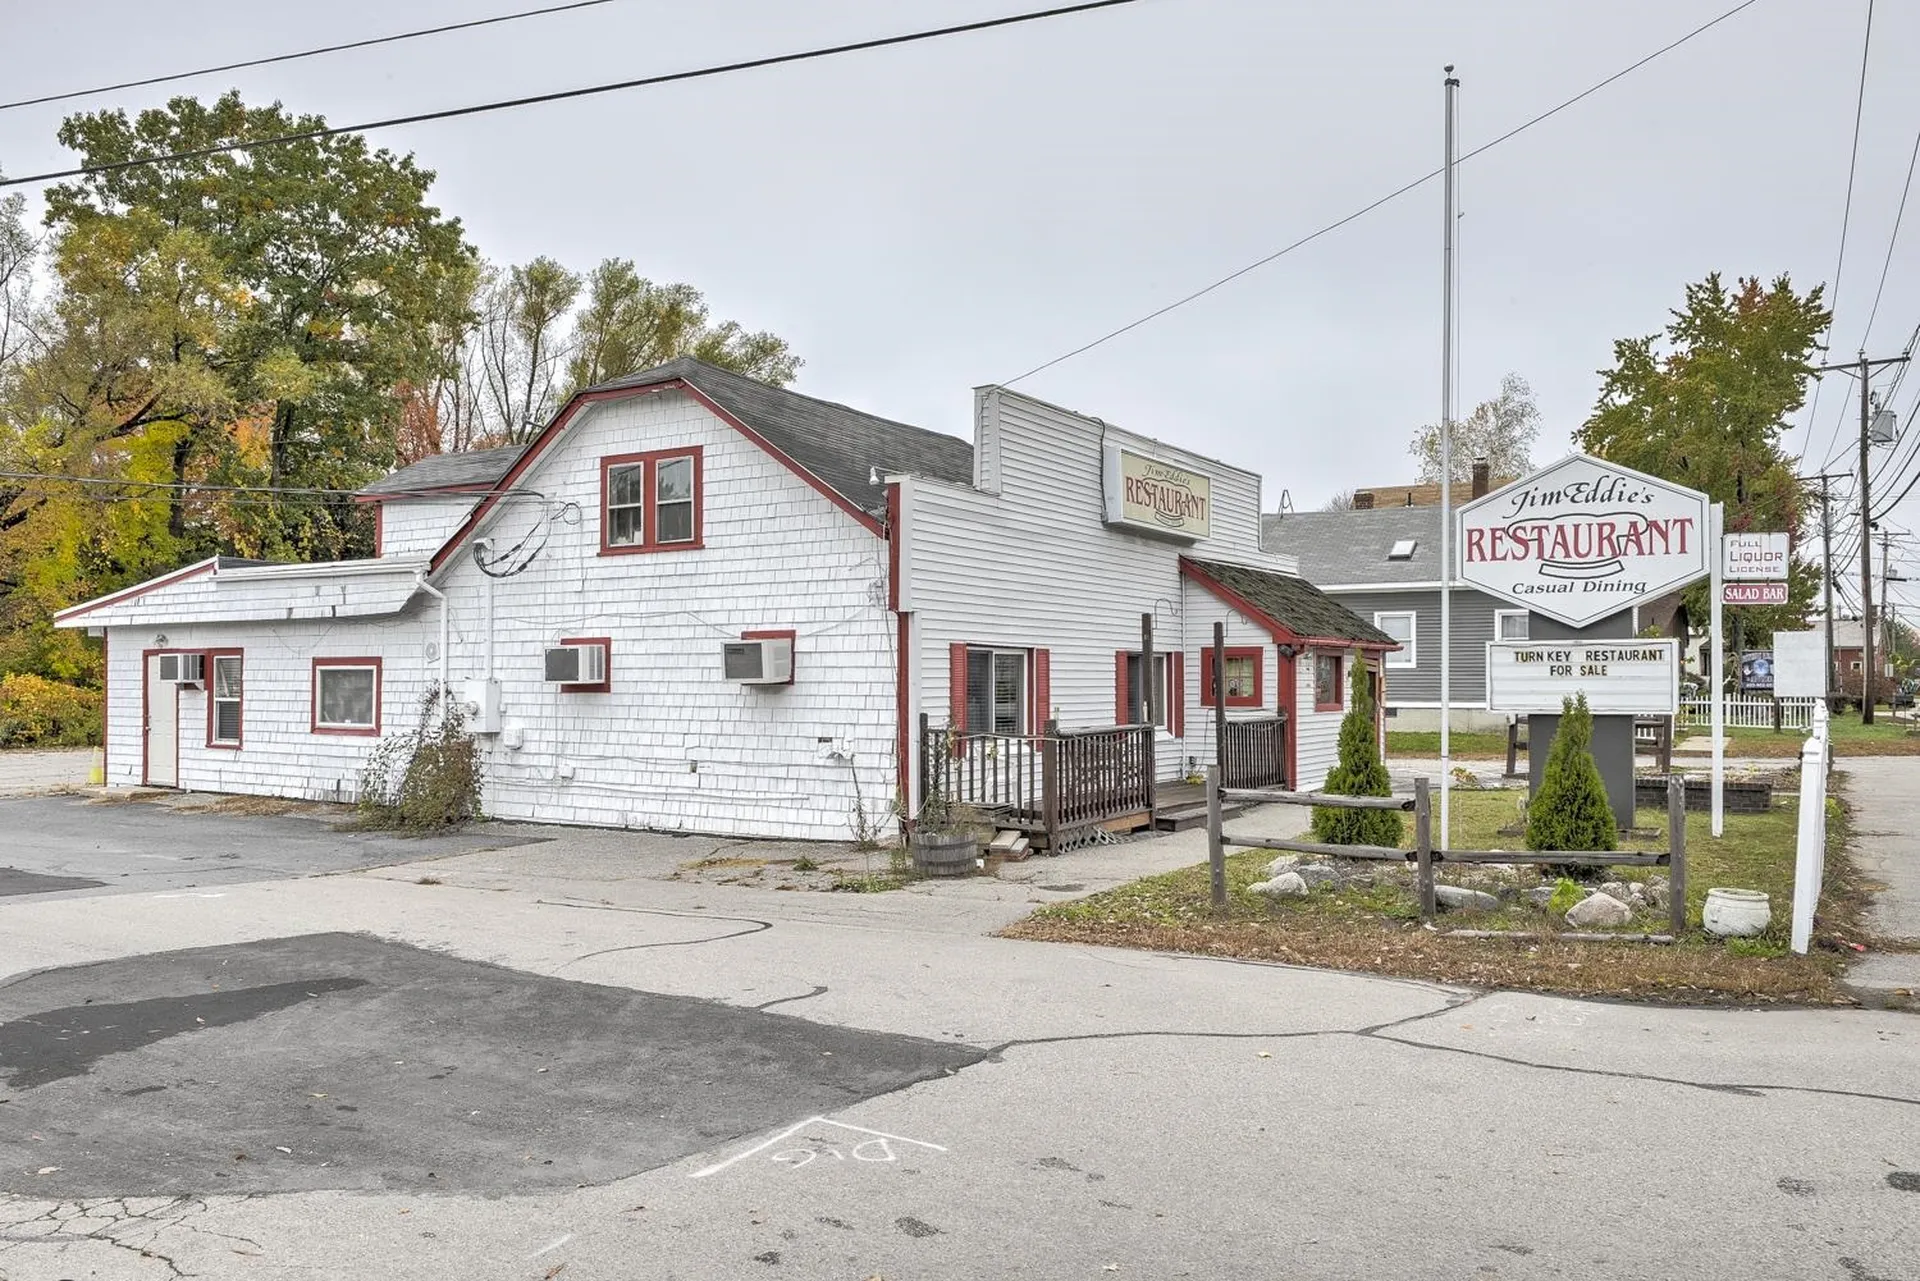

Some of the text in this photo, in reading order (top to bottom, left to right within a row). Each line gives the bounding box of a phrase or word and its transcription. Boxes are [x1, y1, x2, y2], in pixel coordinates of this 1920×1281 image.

[1126, 476, 1206, 520] RESTAURANT
[1466, 518, 1694, 562] RESTAURANT
[1730, 540, 1761, 548] FULL
[1730, 551, 1784, 563] LIQUOR
[1729, 565, 1781, 573] LICENSE
[1512, 579, 1648, 595] Casual Dining
[1725, 588, 1785, 600] SALAD BAR
[1515, 650, 1664, 663] TURN KEY RESTAURANT
[1550, 665, 1608, 676] FOR SALE
